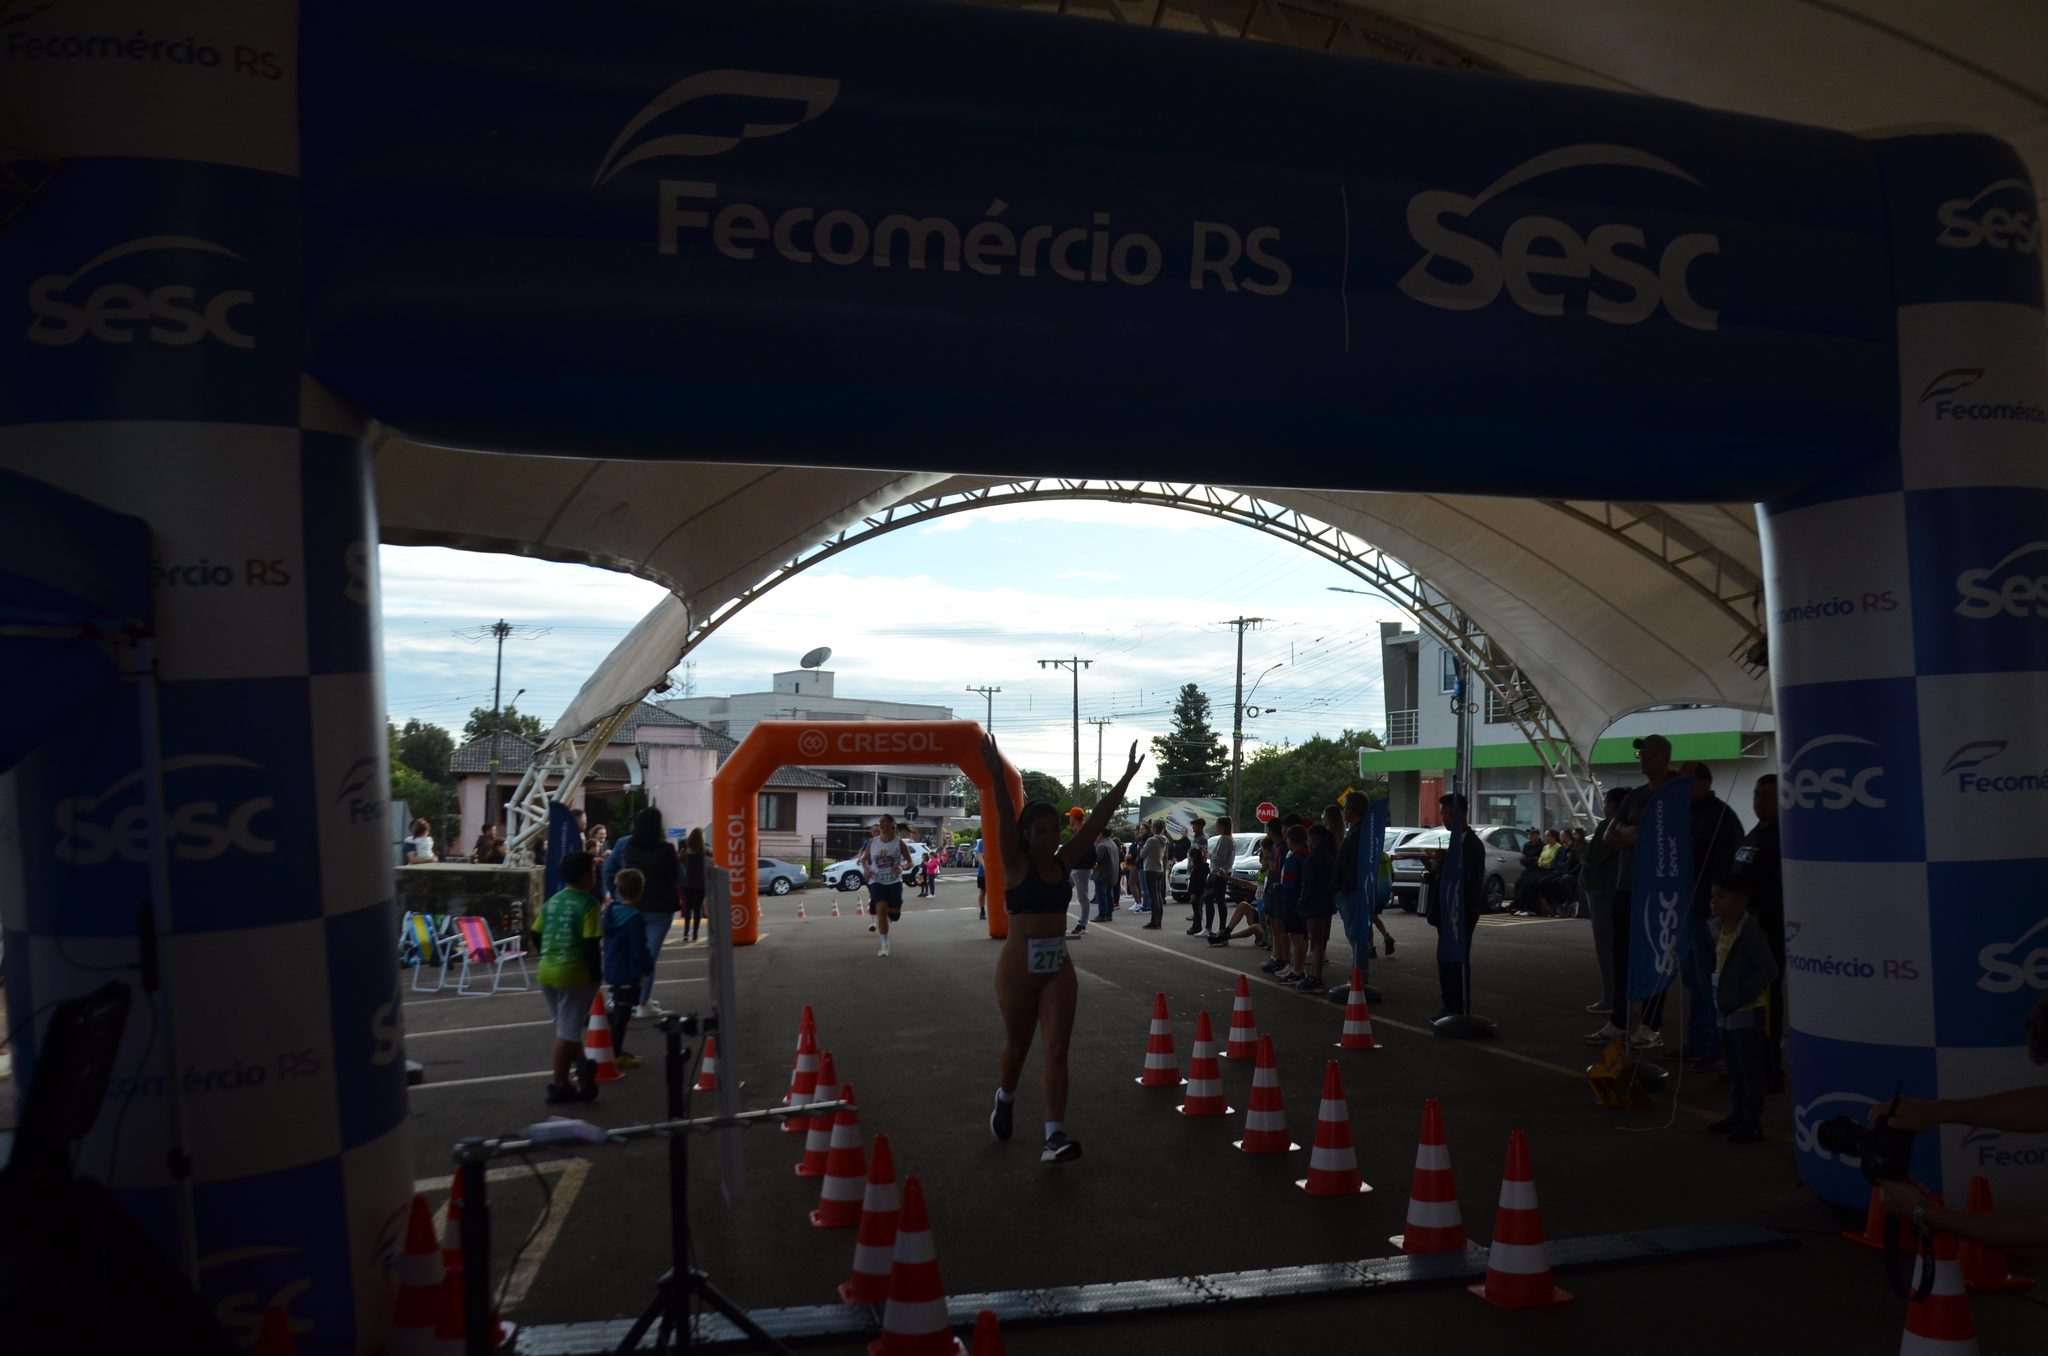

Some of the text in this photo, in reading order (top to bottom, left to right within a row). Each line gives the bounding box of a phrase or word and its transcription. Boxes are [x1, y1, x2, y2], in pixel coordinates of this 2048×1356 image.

[7, 29, 284, 82] Fecomércio RS
[658, 179, 1293, 297] Fecomércio RS
[1935, 199, 2038, 254] Ses
[1397, 188, 1721, 332] Sesc
[25, 273, 256, 349] Sesc
[152, 558, 291, 587] ércio RS
[1862, 591, 1898, 613] RS
[836, 730, 944, 752] CRESOL
[1959, 769, 2048, 793] Fecomé
[53, 795, 275, 867] Sesc
[1258, 808, 1276, 816] PARE
[727, 807, 746, 897] CRESOL
[1654, 891, 1680, 977] Sesc
[1882, 959, 1919, 980] RS
[277, 1050, 321, 1081] RS
